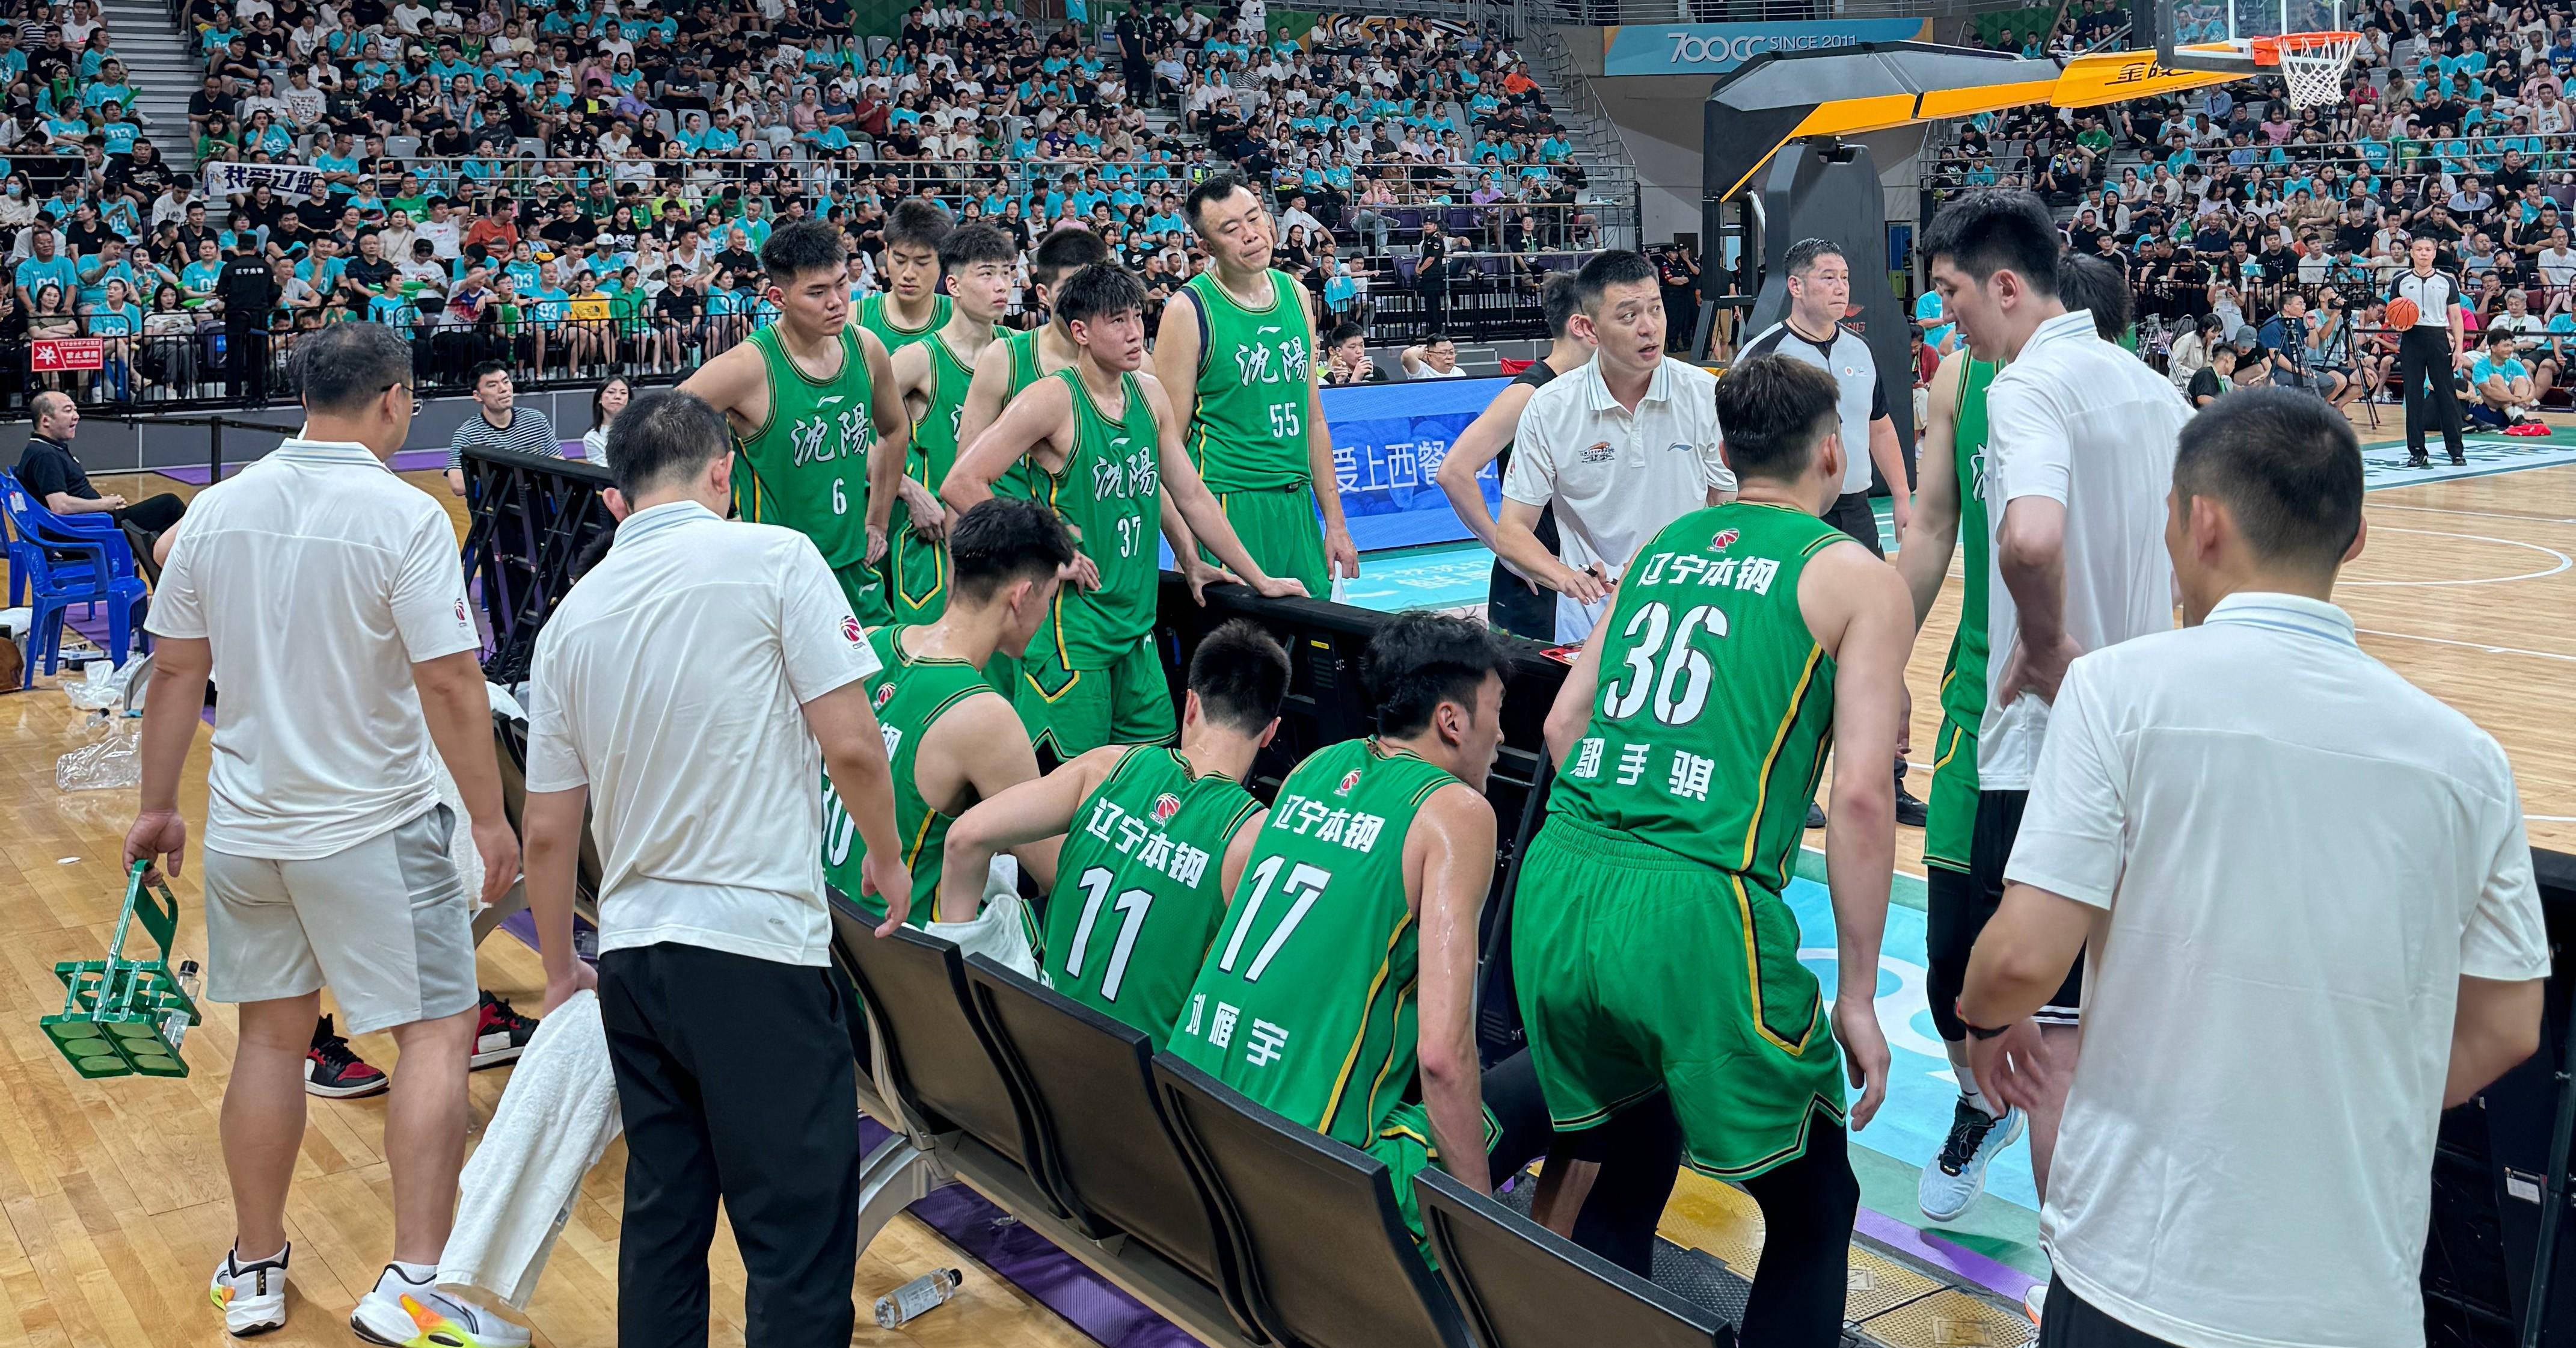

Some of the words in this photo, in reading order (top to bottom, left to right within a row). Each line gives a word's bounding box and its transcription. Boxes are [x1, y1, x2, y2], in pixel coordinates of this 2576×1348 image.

[1667, 32, 1767, 63] 700CC
[1769, 35, 1818, 50] SINCE
[1821, 34, 1857, 48] 2011
[514, 273, 533, 289] 03
[1269, 402, 1300, 438] 55
[1332, 440, 1446, 493] 爱上西餐
[832, 478, 847, 516] 6
[1117, 515, 1141, 558] 37
[1636, 551, 1780, 596] 辽宁本钢
[1602, 600, 1730, 728] 36
[1085, 796, 1210, 889] 辽宁本钢
[1272, 794, 1385, 853] 辽宁本钢
[1065, 864, 1156, 1004] 11
[1218, 853, 1332, 985] 17
